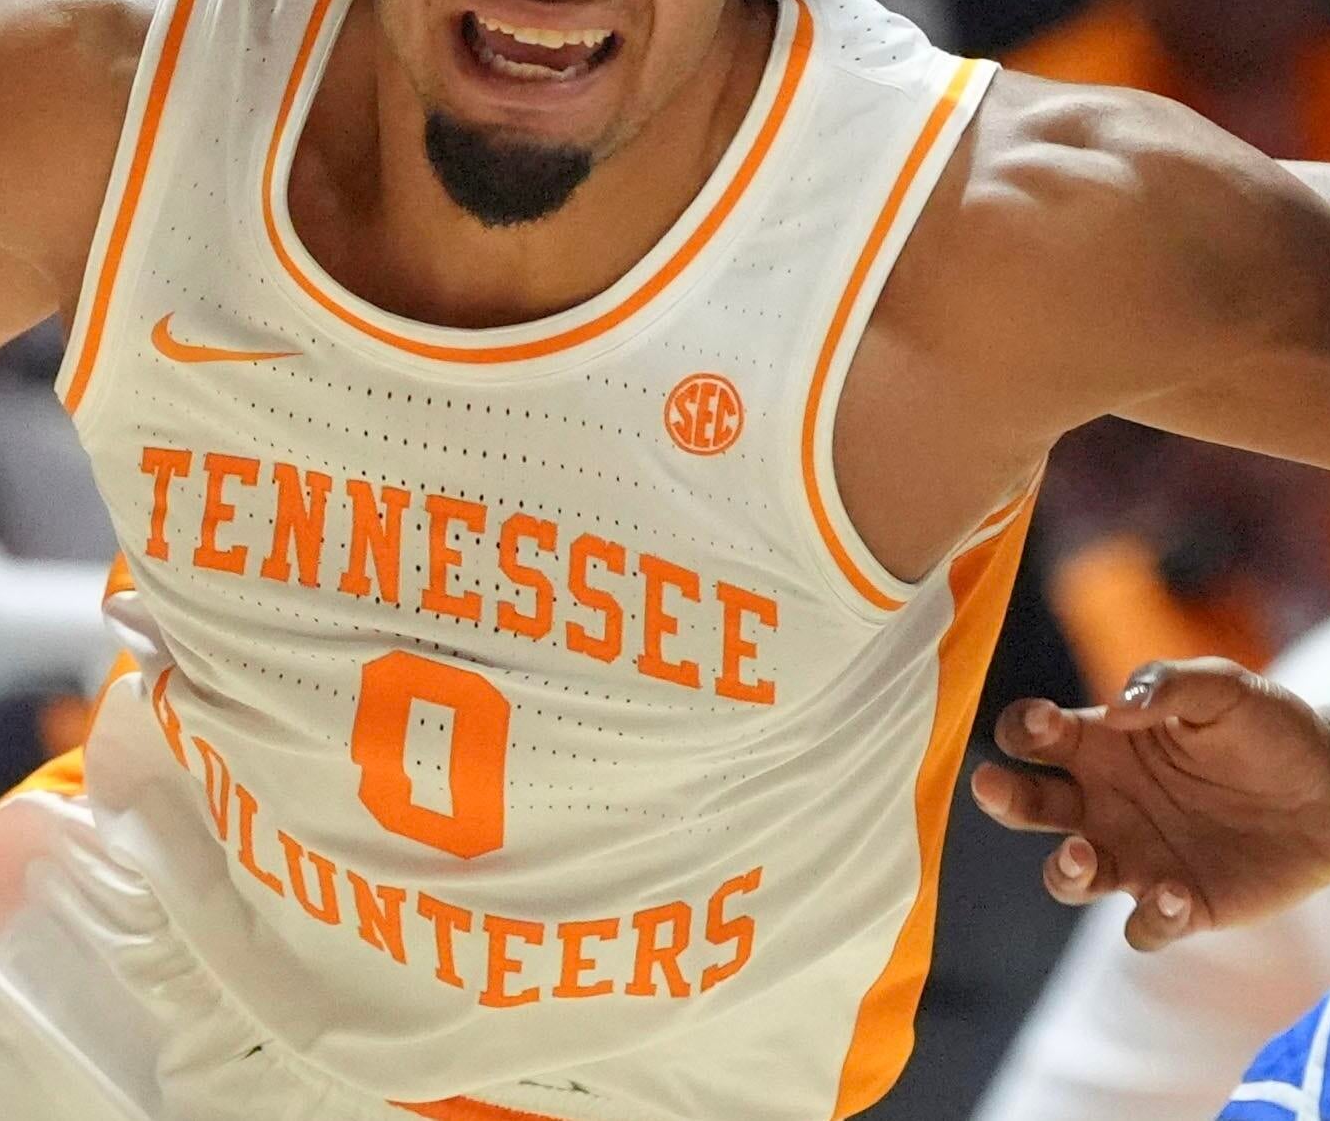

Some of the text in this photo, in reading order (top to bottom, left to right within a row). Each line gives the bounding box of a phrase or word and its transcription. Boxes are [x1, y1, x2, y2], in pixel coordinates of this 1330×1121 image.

[670, 380, 737, 449] SEC
[140, 446, 780, 706] TENNESSEE
[351, 649, 510, 861] 0
